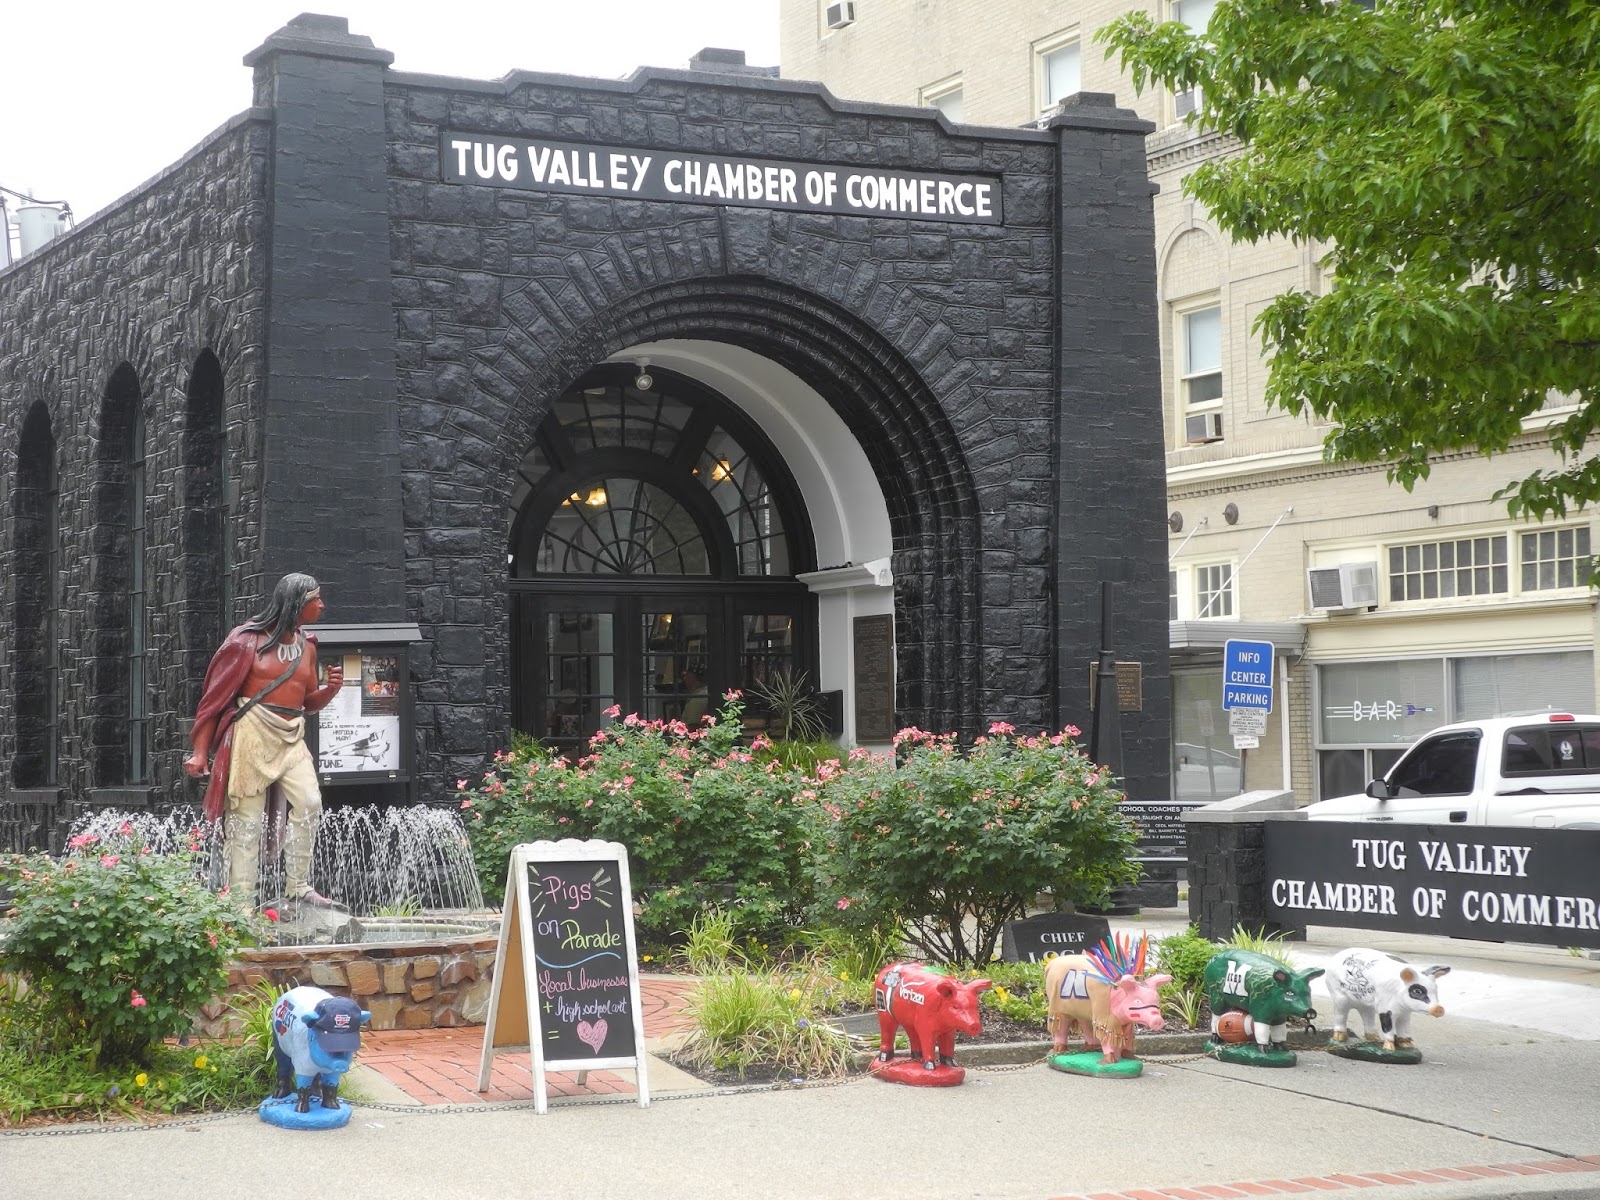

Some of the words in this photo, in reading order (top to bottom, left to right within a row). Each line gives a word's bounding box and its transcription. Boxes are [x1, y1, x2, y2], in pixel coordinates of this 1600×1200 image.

[450, 139, 518, 182] TUG
[527, 145, 653, 193] VALLEY
[663, 159, 798, 204] CHAMBER
[804, 170, 838, 207] OF
[845, 174, 993, 217] COMMERCE
[1238, 651, 1260, 664] INFO
[1231, 670, 1266, 684] CENTER
[1227, 691, 1268, 705] PARKING
[1353, 700, 1402, 722] BAR
[319, 759, 343, 769] JUNE
[1352, 838, 1407, 870] TUG
[1418, 841, 1532, 877] VALLEY
[542, 876, 593, 910] Pigs
[1271, 878, 1398, 915] CHAMBER
[1412, 886, 1447, 919] OF
[1462, 890, 1600, 930] COMMER
[537, 919, 561, 940] on
[560, 919, 622, 950] Parade
[1040, 932, 1086, 944] CHIEF
[576, 967, 628, 992] businesses
[554, 995, 583, 1023] high
[582, 999, 612, 1019] school
[611, 997, 627, 1014] art
